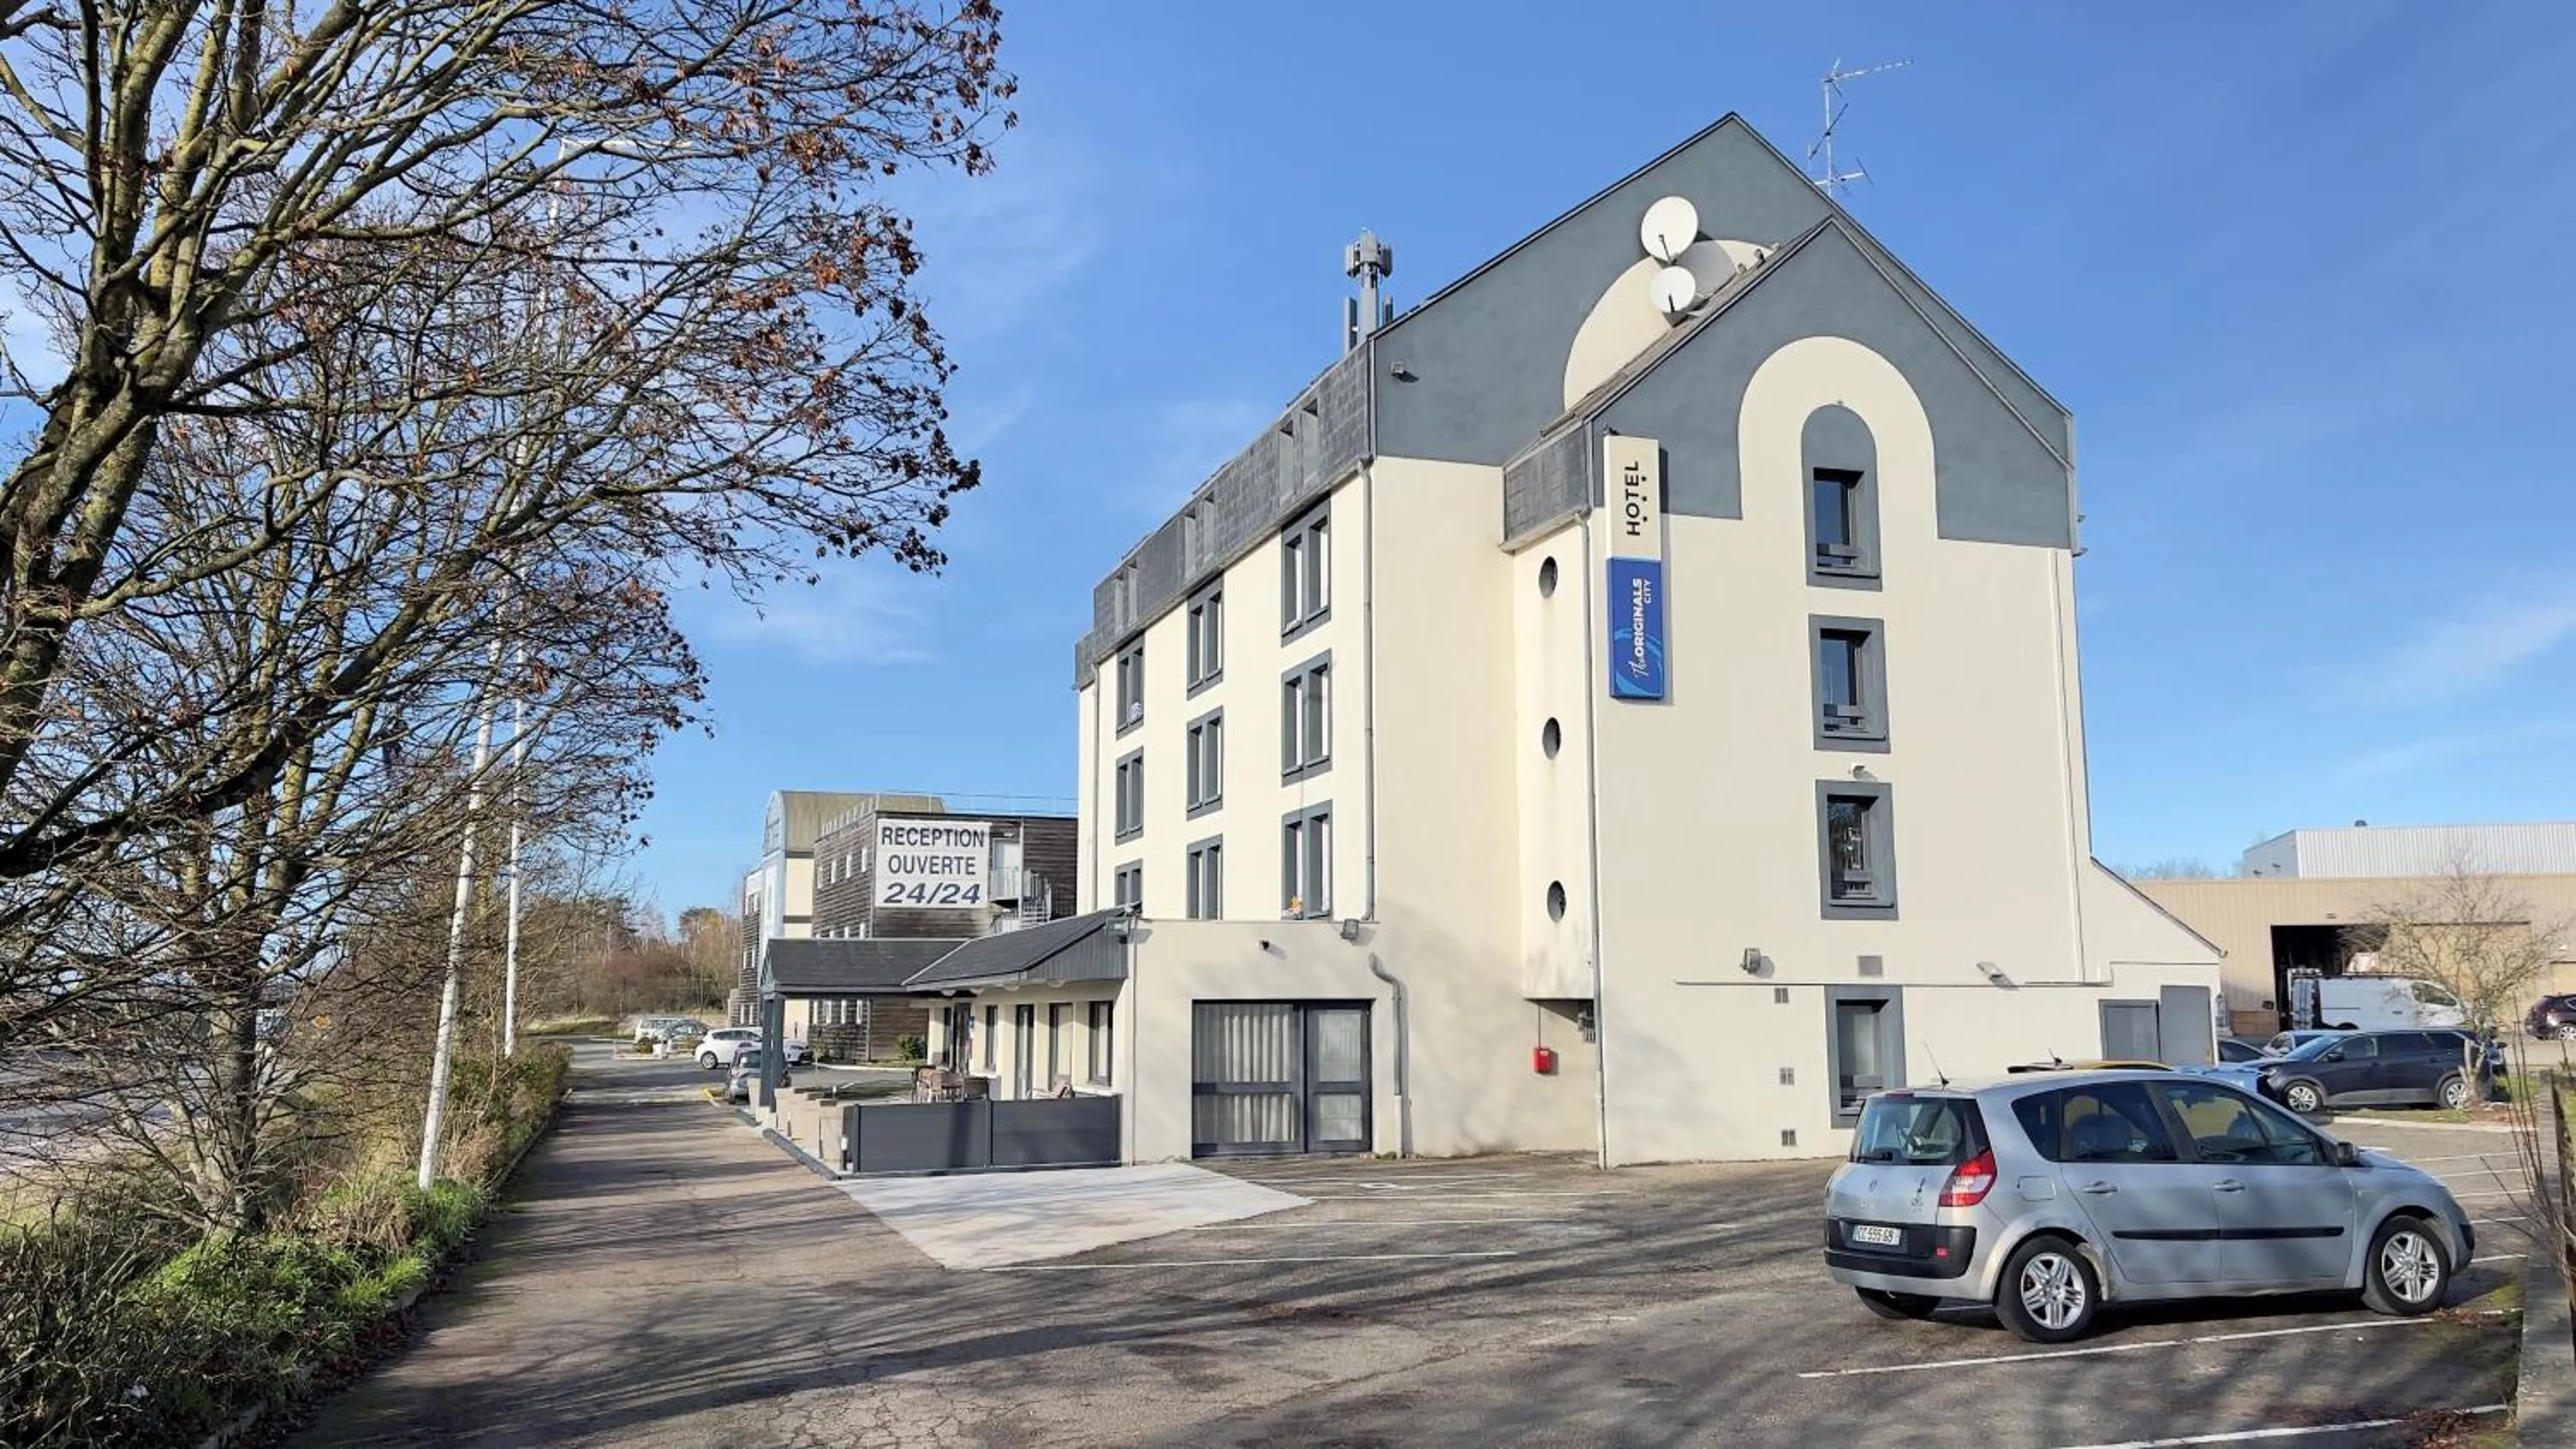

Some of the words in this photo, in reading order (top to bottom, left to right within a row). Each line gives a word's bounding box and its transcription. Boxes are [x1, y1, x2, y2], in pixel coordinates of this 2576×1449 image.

[1625, 461, 1641, 536] HOTEL
[1643, 579, 1652, 604] CITY
[1632, 578, 1644, 658] ORIGINALS
[881, 827, 985, 847] RECEPTION
[888, 854, 976, 875] OUVERTE
[884, 882, 981, 904] 24/24
